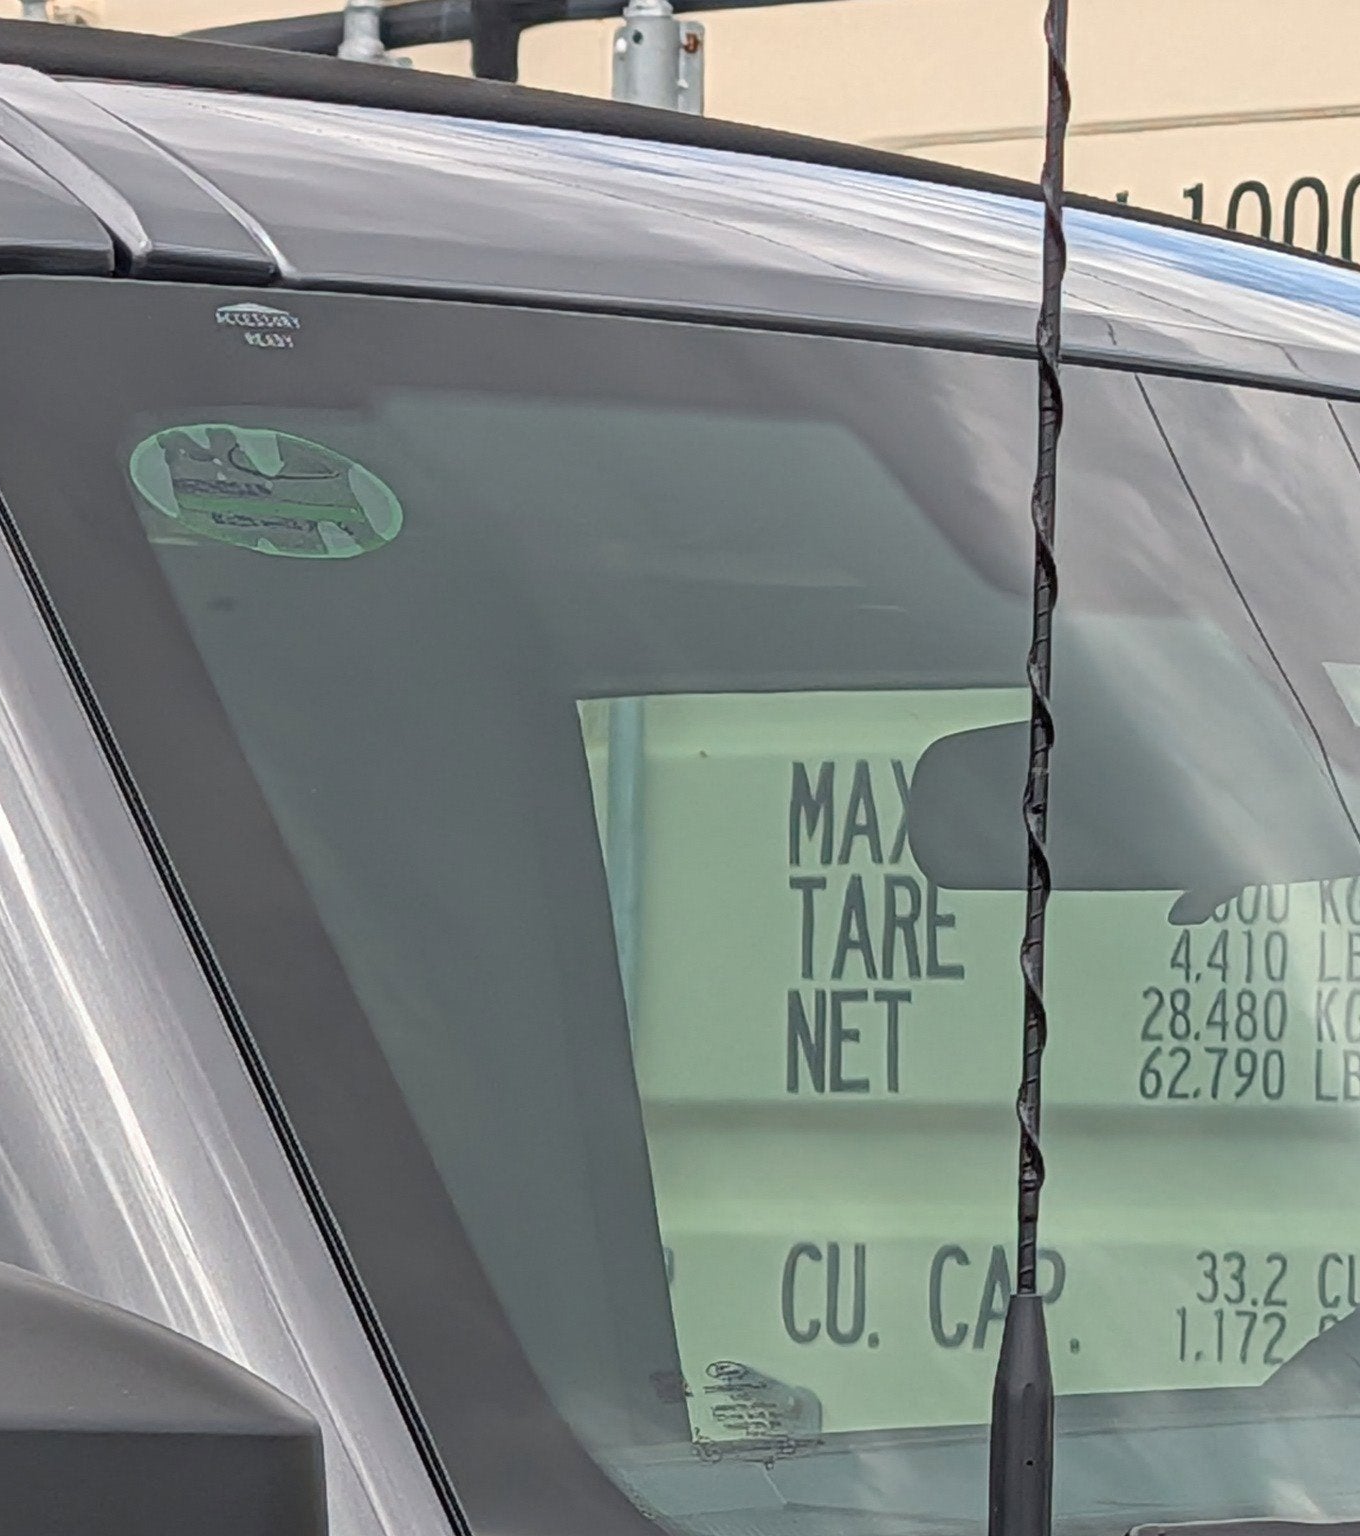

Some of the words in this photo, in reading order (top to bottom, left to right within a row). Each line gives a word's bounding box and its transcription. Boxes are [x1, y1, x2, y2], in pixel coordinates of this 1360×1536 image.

[789, 873, 965, 980] TARE
[786, 988, 912, 1094] NET
[1141, 986, 1288, 1042] 28.480
[1139, 1045, 1285, 1100] 62.790
[781, 1242, 879, 1346] CU.
[1196, 1250, 1288, 1307] 33.2
[1177, 1306, 1287, 1365] 1.172
